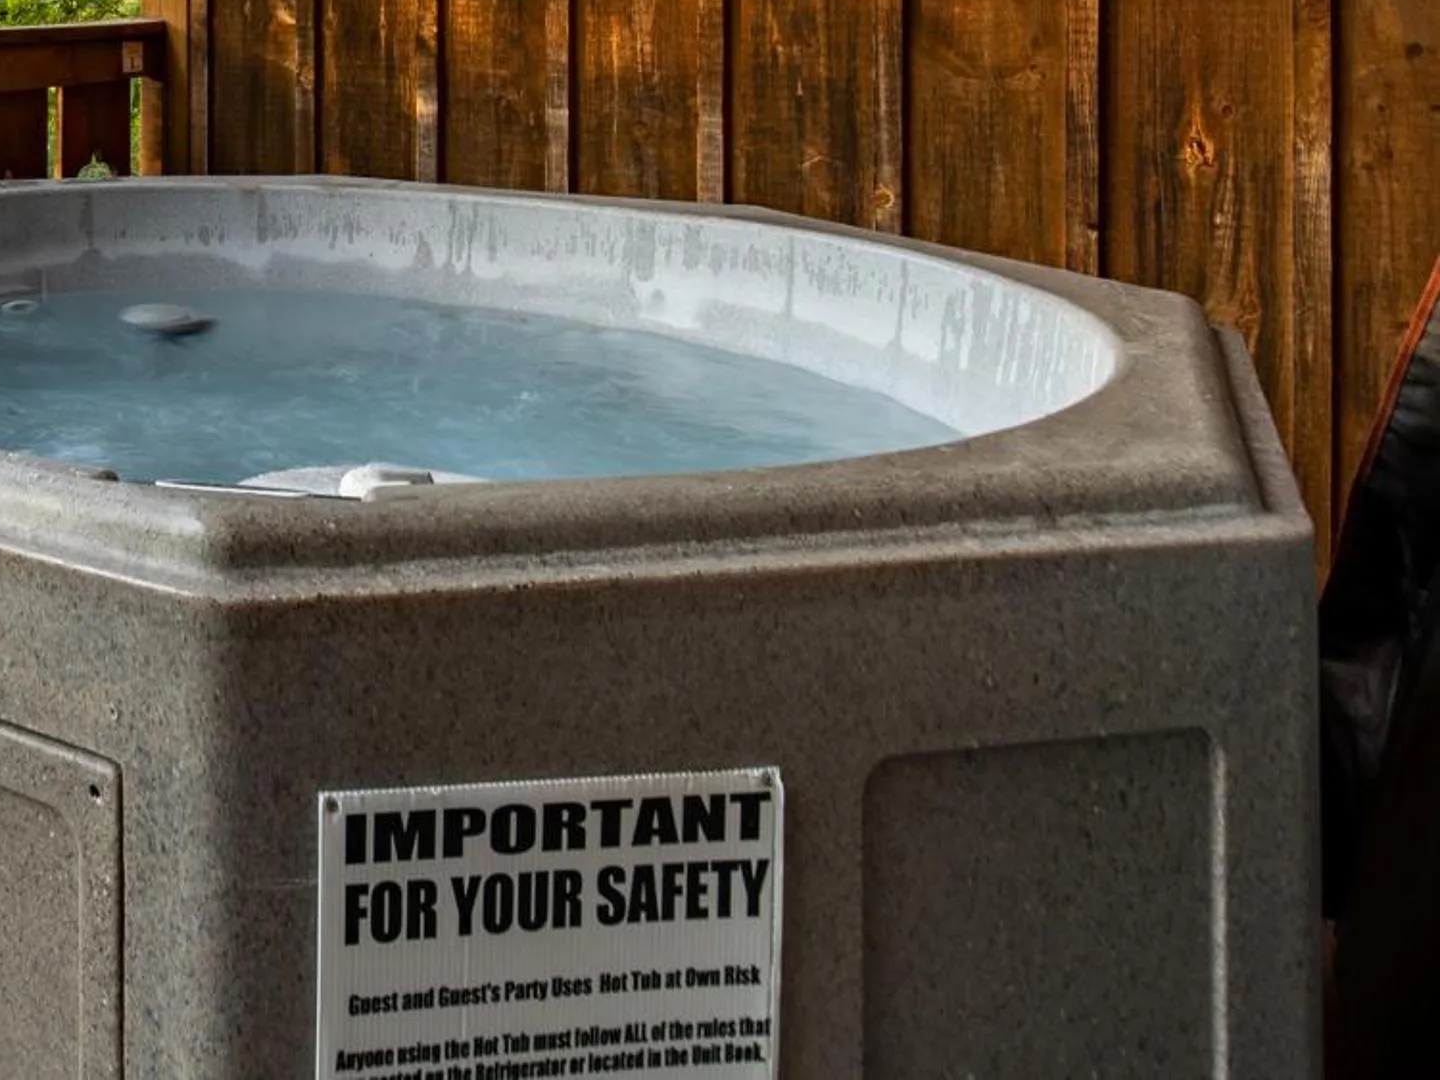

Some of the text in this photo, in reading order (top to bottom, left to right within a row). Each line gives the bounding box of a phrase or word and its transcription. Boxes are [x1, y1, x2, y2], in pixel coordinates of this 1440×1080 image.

[345, 791, 771, 865] IMPORTANT
[345, 858, 769, 946] FOR YOUR SAFETY
[349, 964, 760, 1016] Guest and Guest's Party Uses Hot Tub at Own Risk
[336, 1017, 771, 1071] Anyone using the Hot Tub must follow ALL of the rules that
[588, 1048, 644, 1073] located
[647, 1047, 662, 1068] in
[665, 1046, 689, 1066] the
[692, 1044, 722, 1066] Unit
